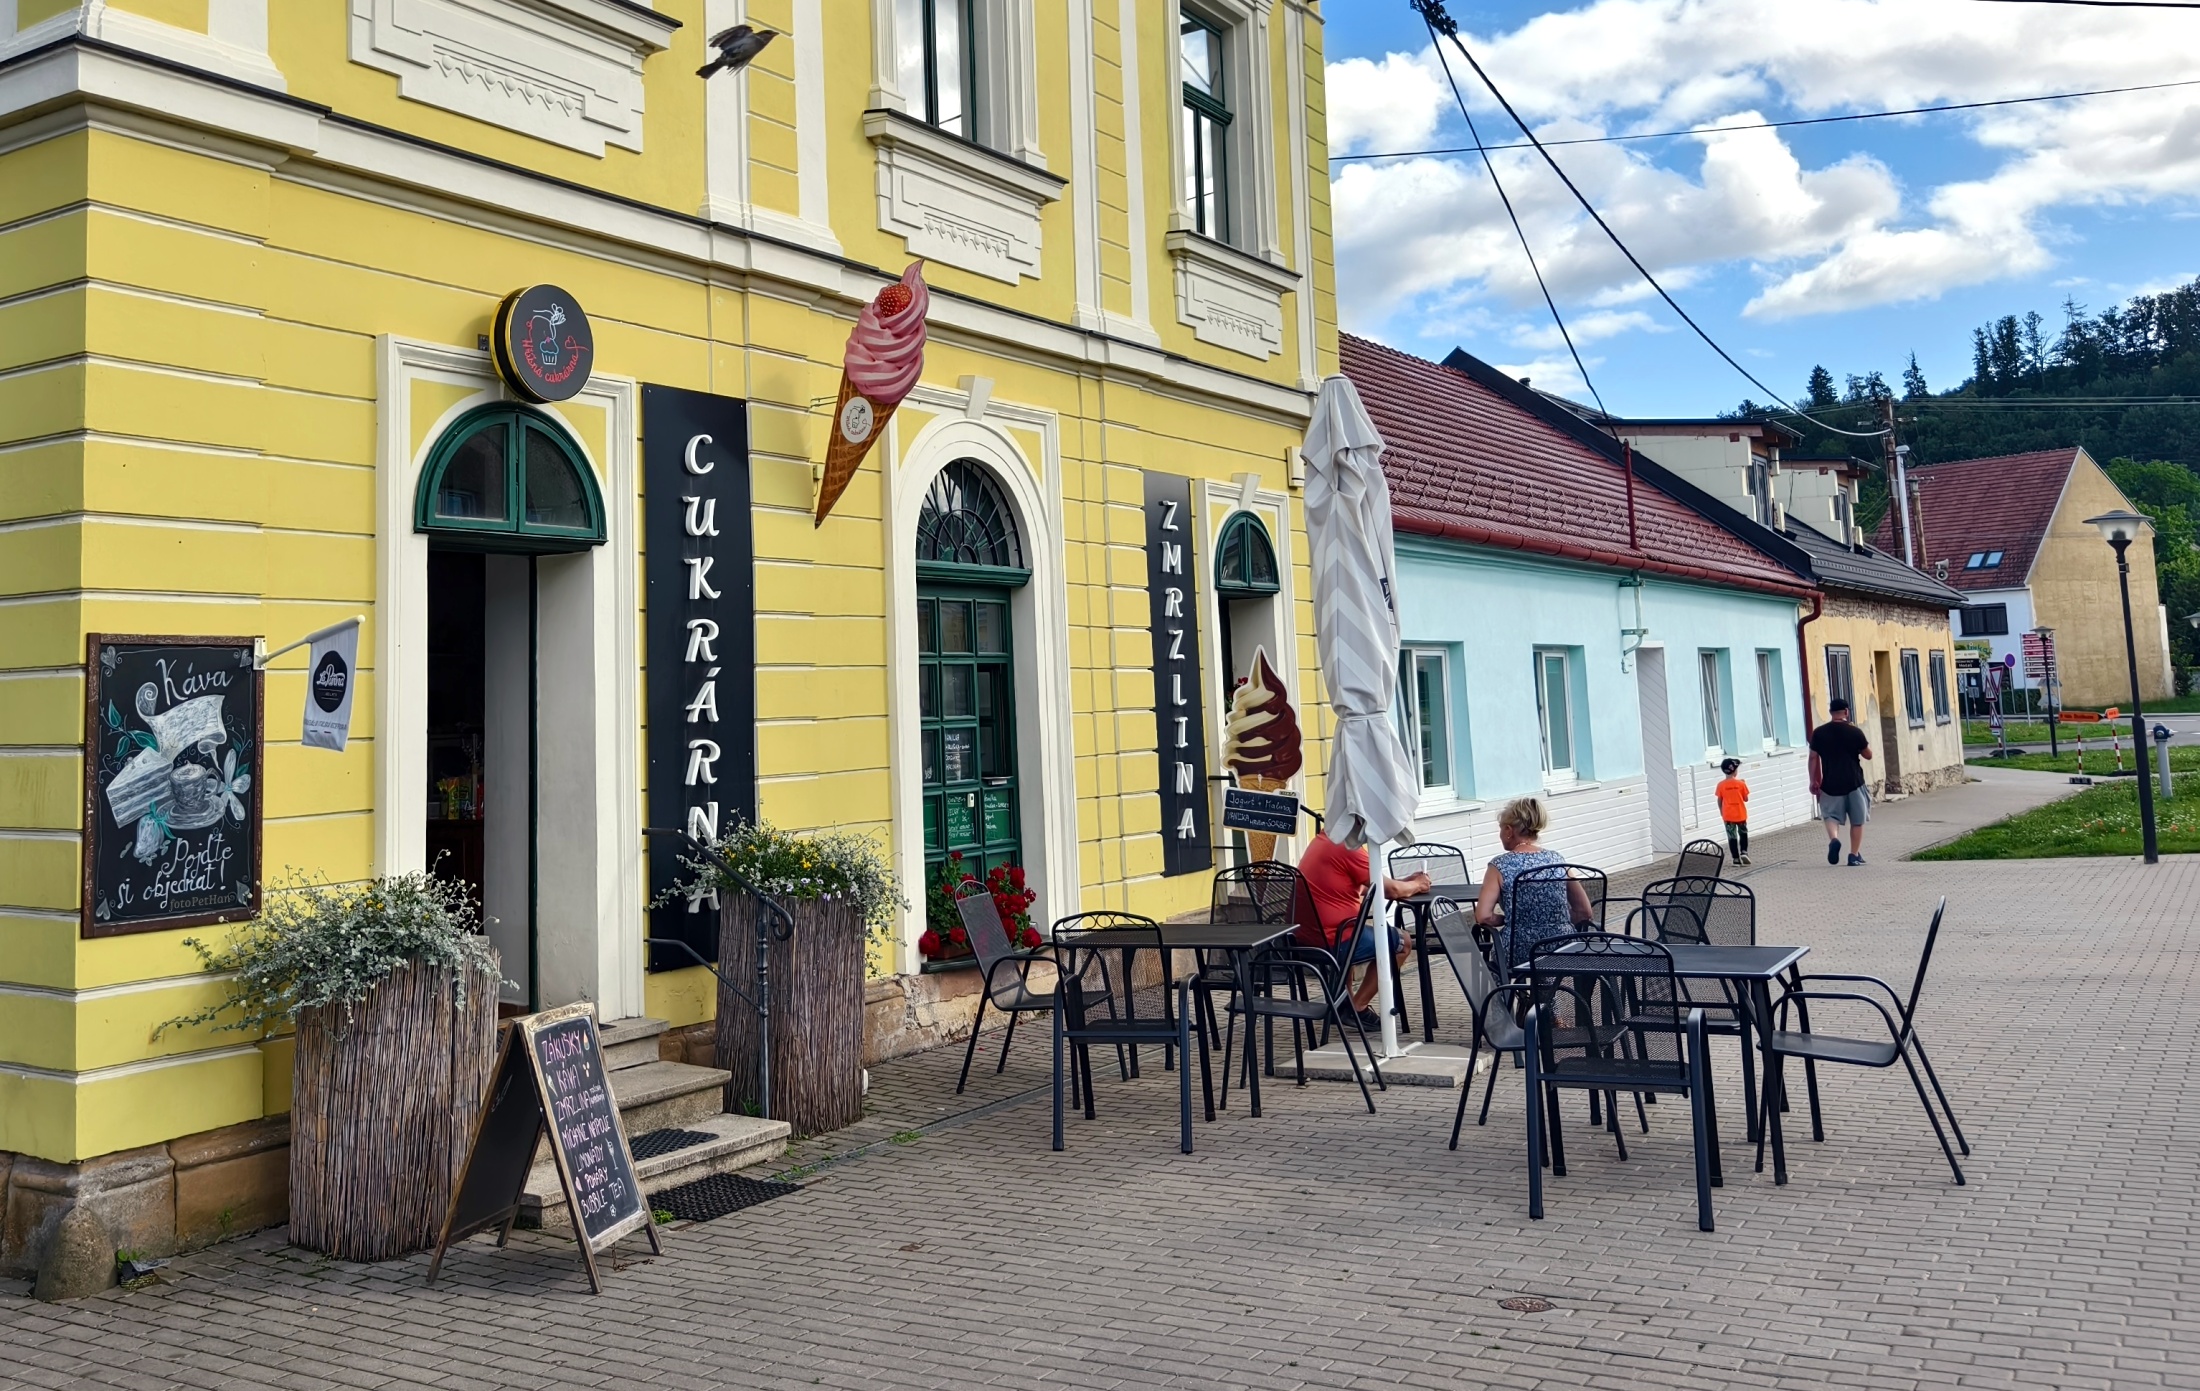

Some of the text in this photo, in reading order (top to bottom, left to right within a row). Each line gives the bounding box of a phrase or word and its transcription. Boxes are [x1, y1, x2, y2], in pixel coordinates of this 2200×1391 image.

[156, 658, 234, 705] Káva
[1157, 500, 1196, 840] ZMRZLINA
[1229, 793, 1255, 808] Jogurt
[1265, 799, 1293, 813] Malina
[556, 1061, 581, 1093] KÁVA
[561, 1112, 611, 1151] MÍCHANÉ NÁPOJE
[575, 1142, 604, 1172] LIMONÁDY
[584, 1166, 608, 1192] POHÁRY
[581, 1177, 627, 1219] BUBBLE TEA
